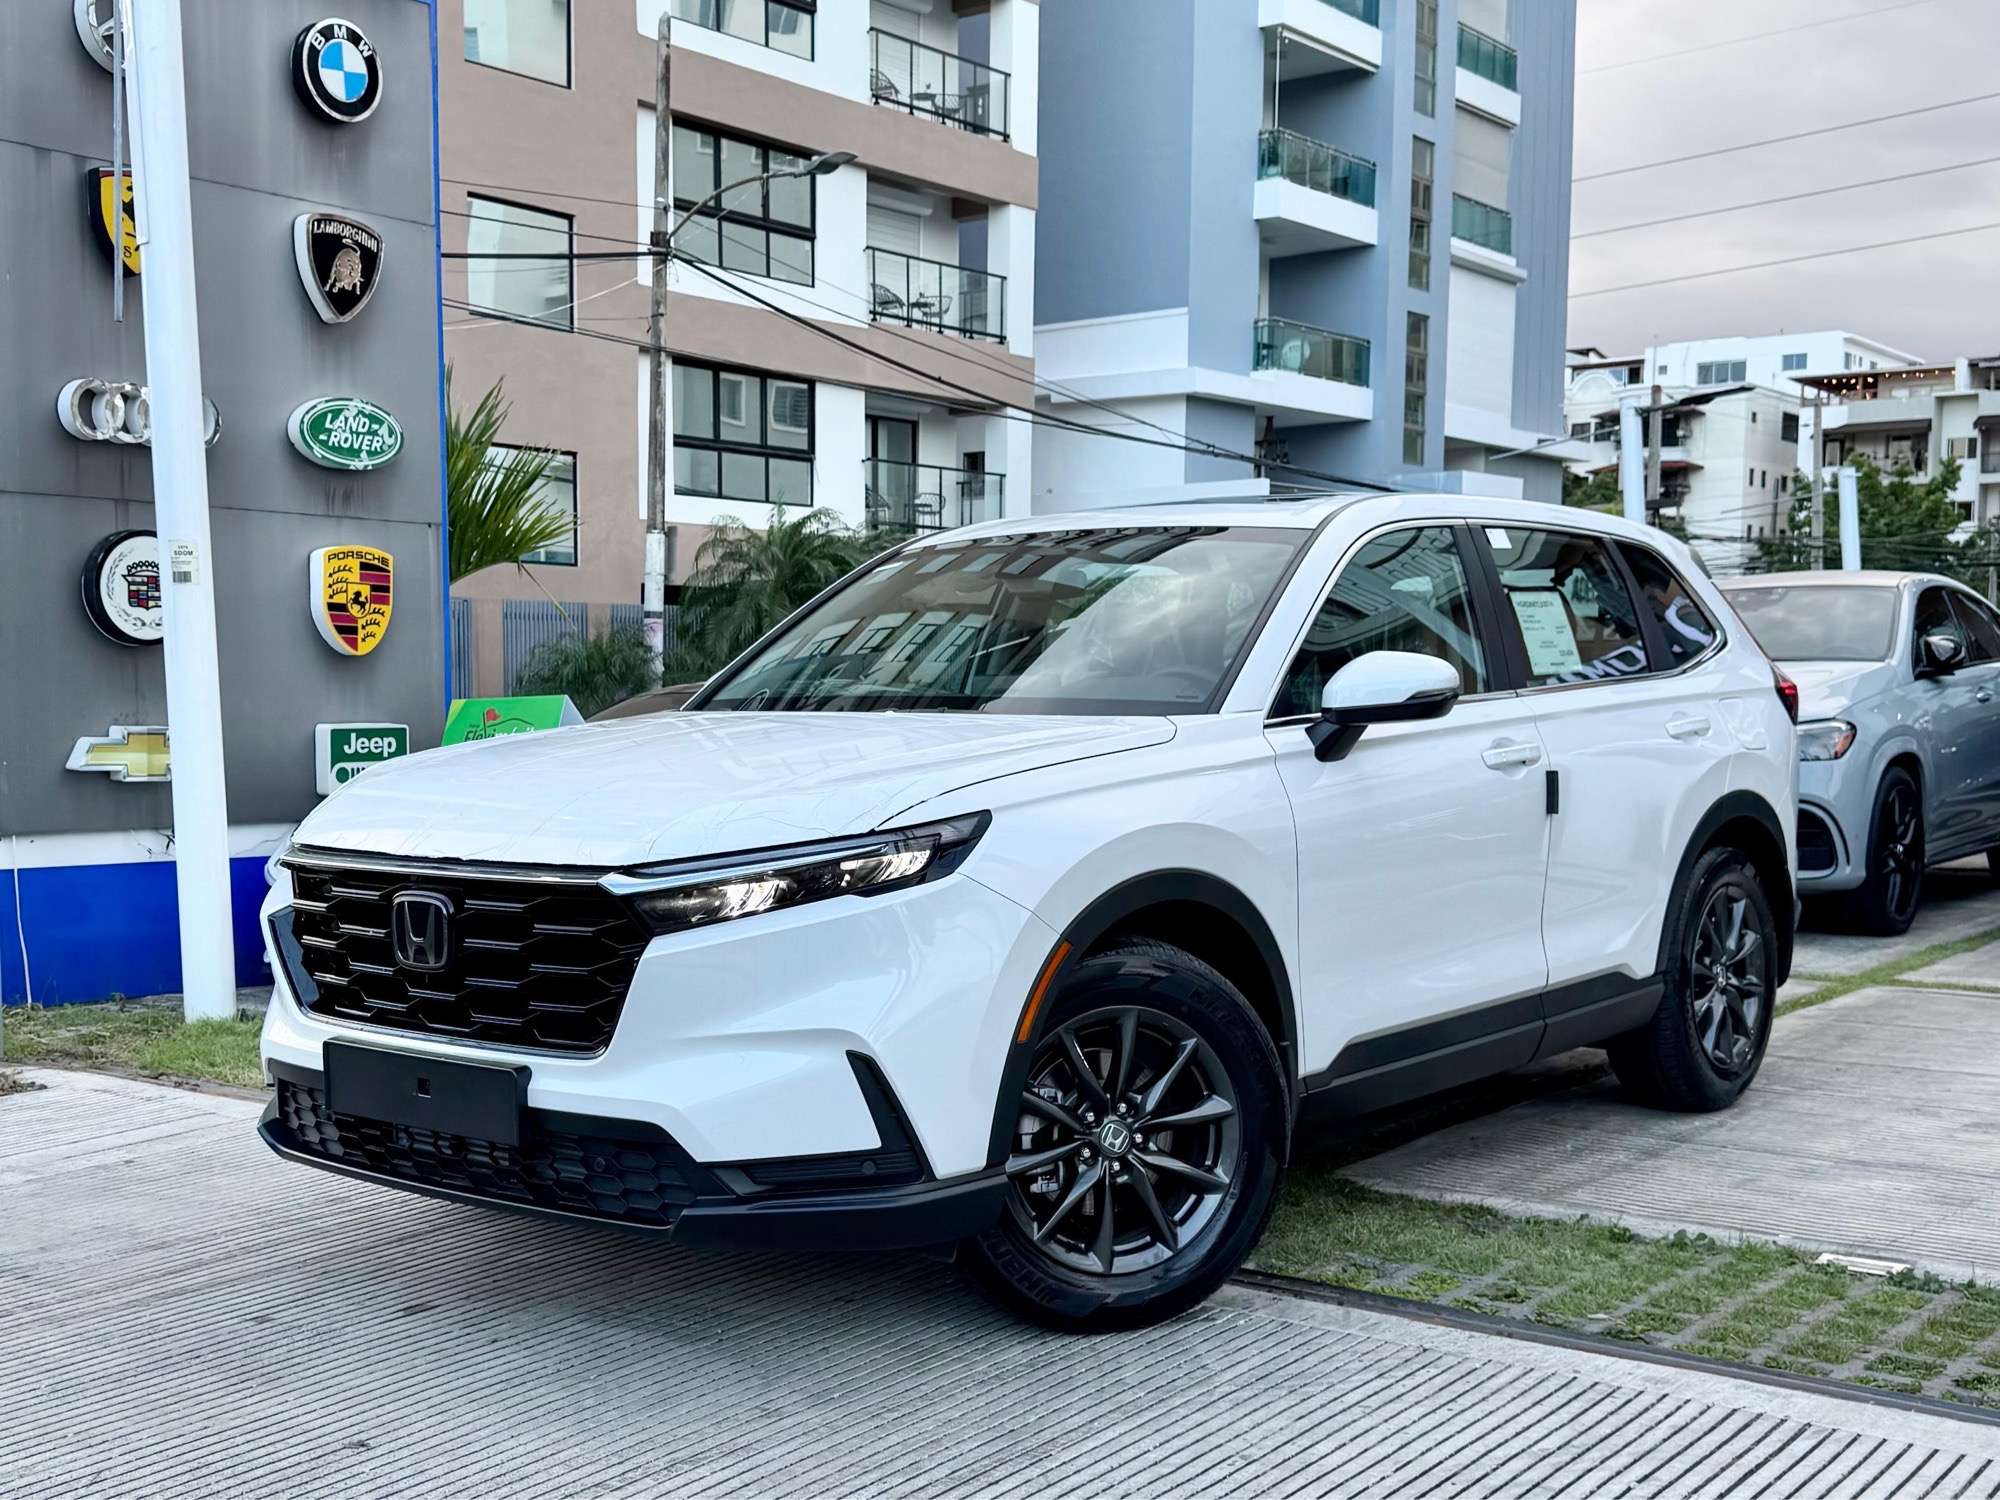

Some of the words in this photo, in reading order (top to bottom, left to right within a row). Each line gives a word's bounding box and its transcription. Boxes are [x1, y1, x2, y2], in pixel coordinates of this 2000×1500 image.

[311, 24, 373, 58] BMW
[313, 220, 378, 252] LAMBORGHINI
[123, 245, 132, 257] S
[327, 550, 391, 568] PORSCHE
[343, 732, 397, 757] Jeep
